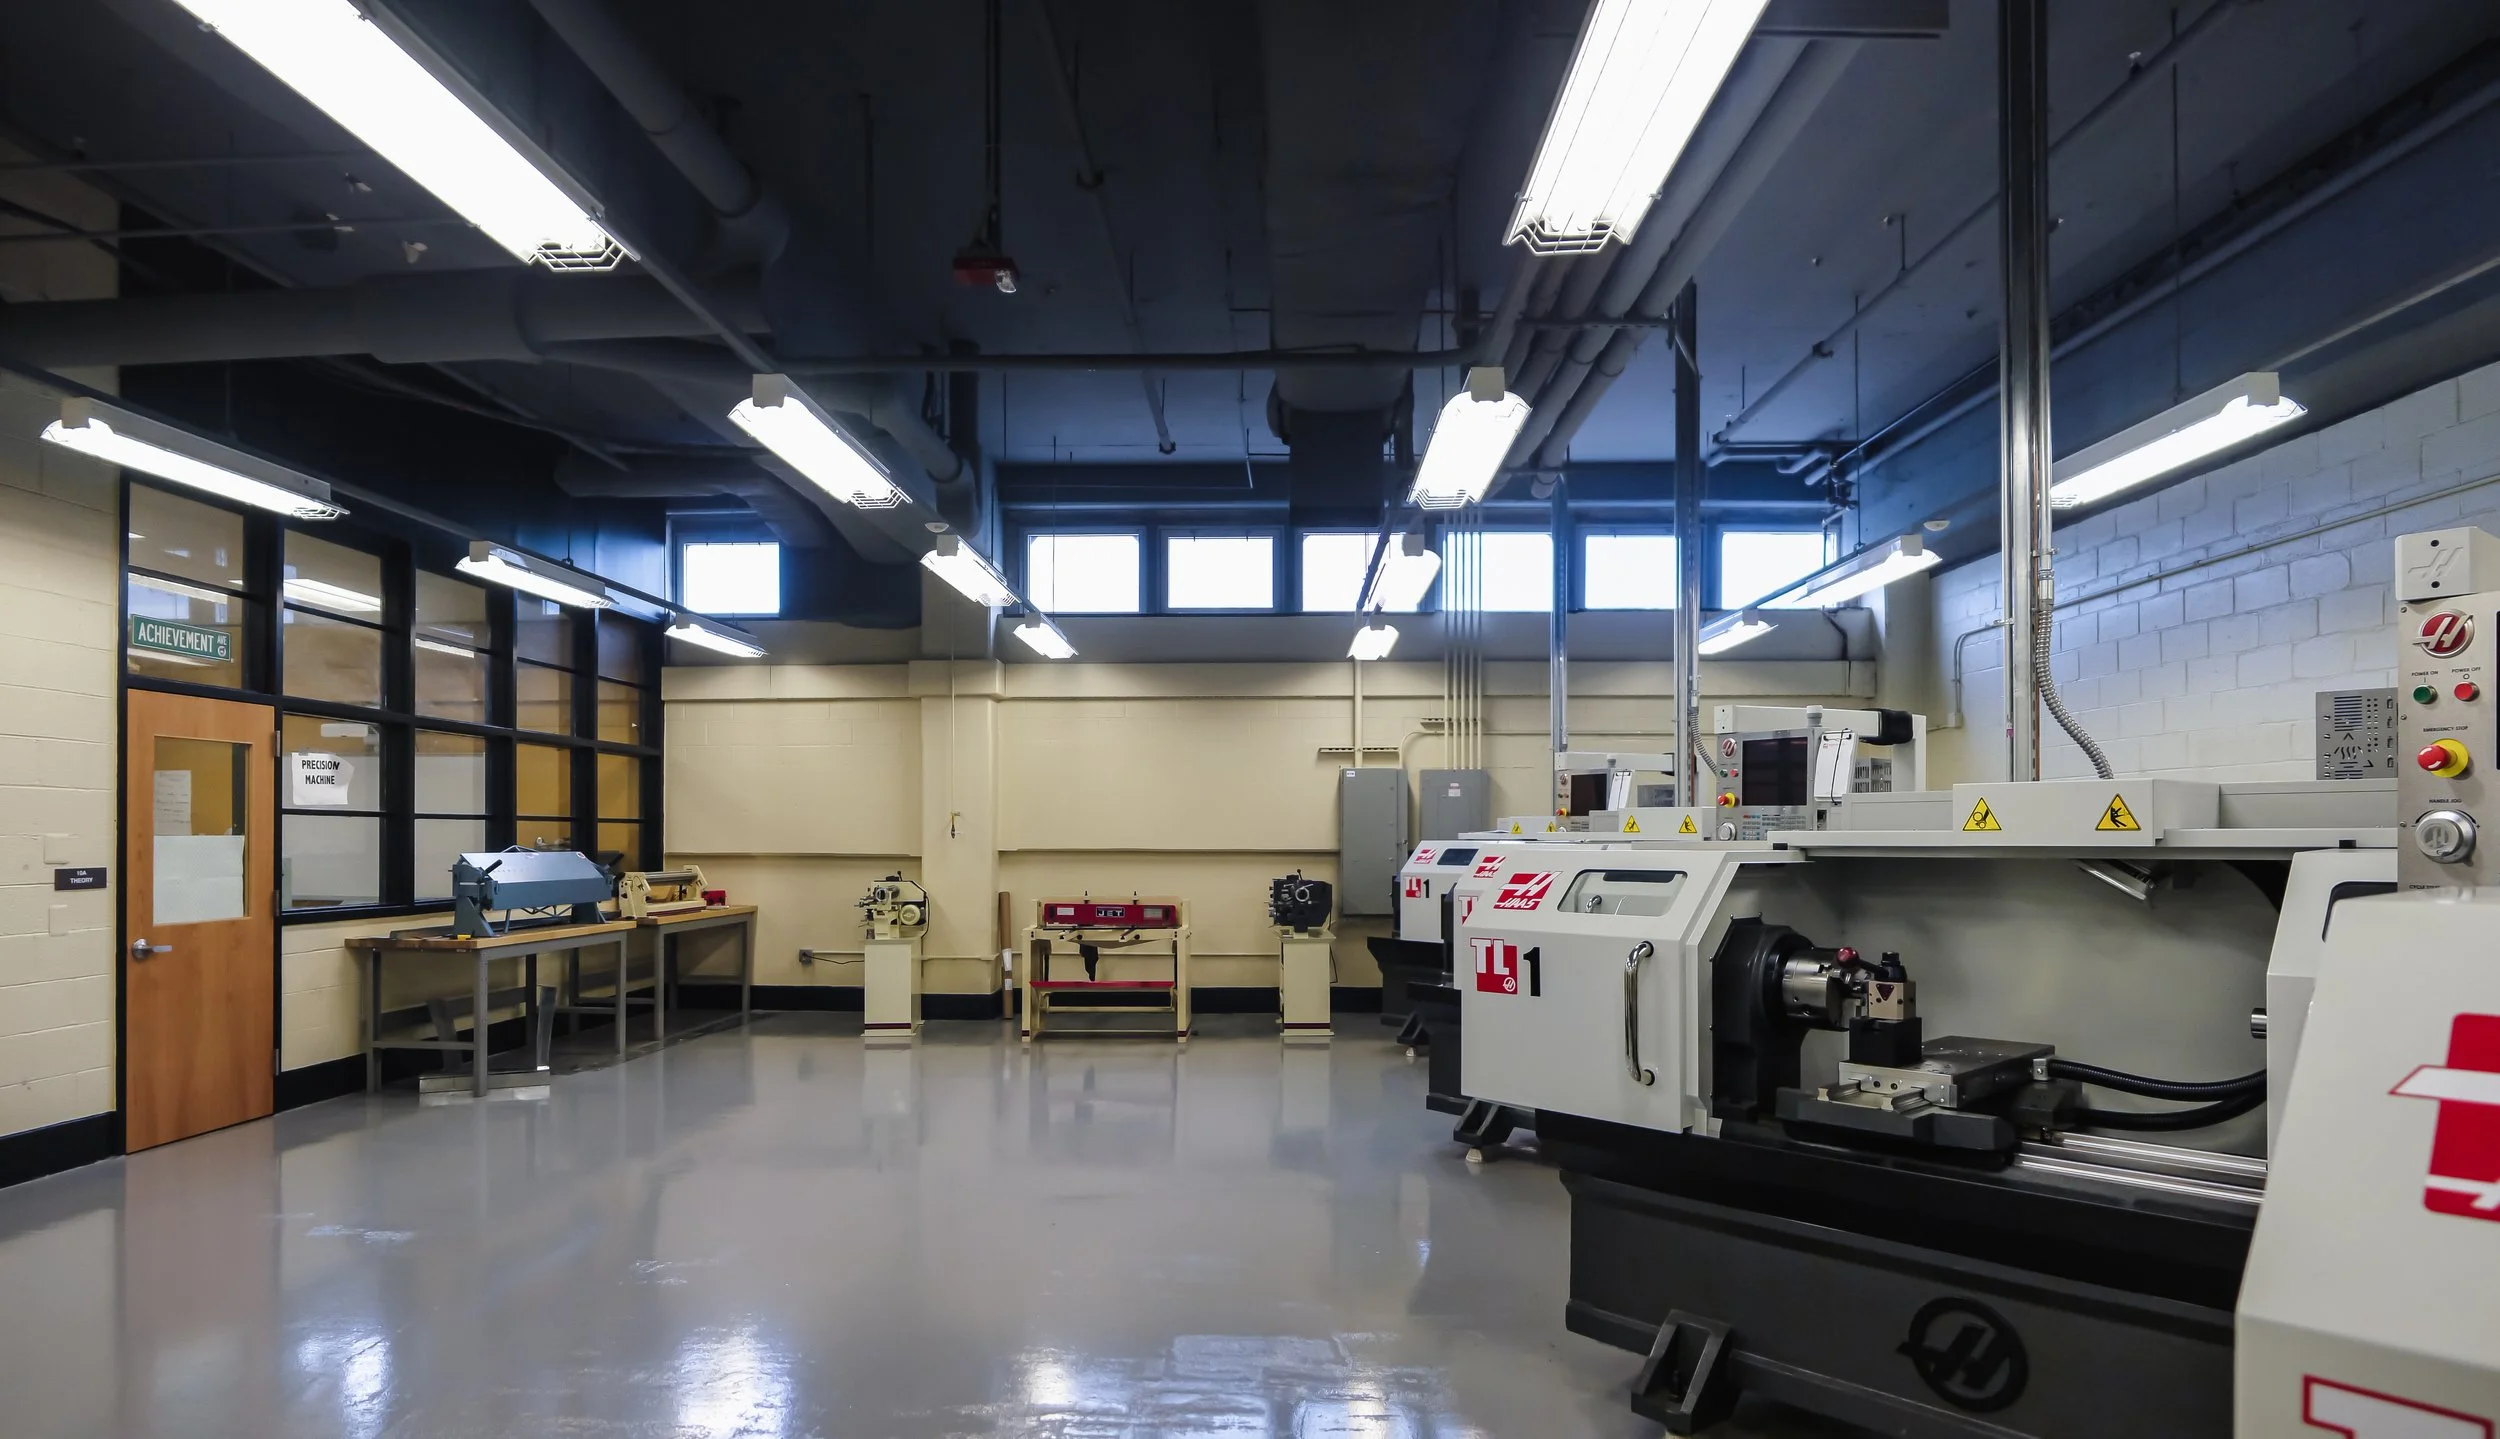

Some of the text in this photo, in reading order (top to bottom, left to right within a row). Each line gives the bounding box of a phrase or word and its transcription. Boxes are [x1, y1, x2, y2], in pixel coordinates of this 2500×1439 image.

[138, 622, 227, 653] ACHIEVEMENT AVE
[301, 759, 340, 770] PRECISION
[305, 774, 335, 785] MACHINE
[1423, 879, 1430, 899] 1
[1496, 897, 1542, 909] HAAS
[1098, 909, 1123, 917] JET
[1470, 937, 1541, 997] TL 1
